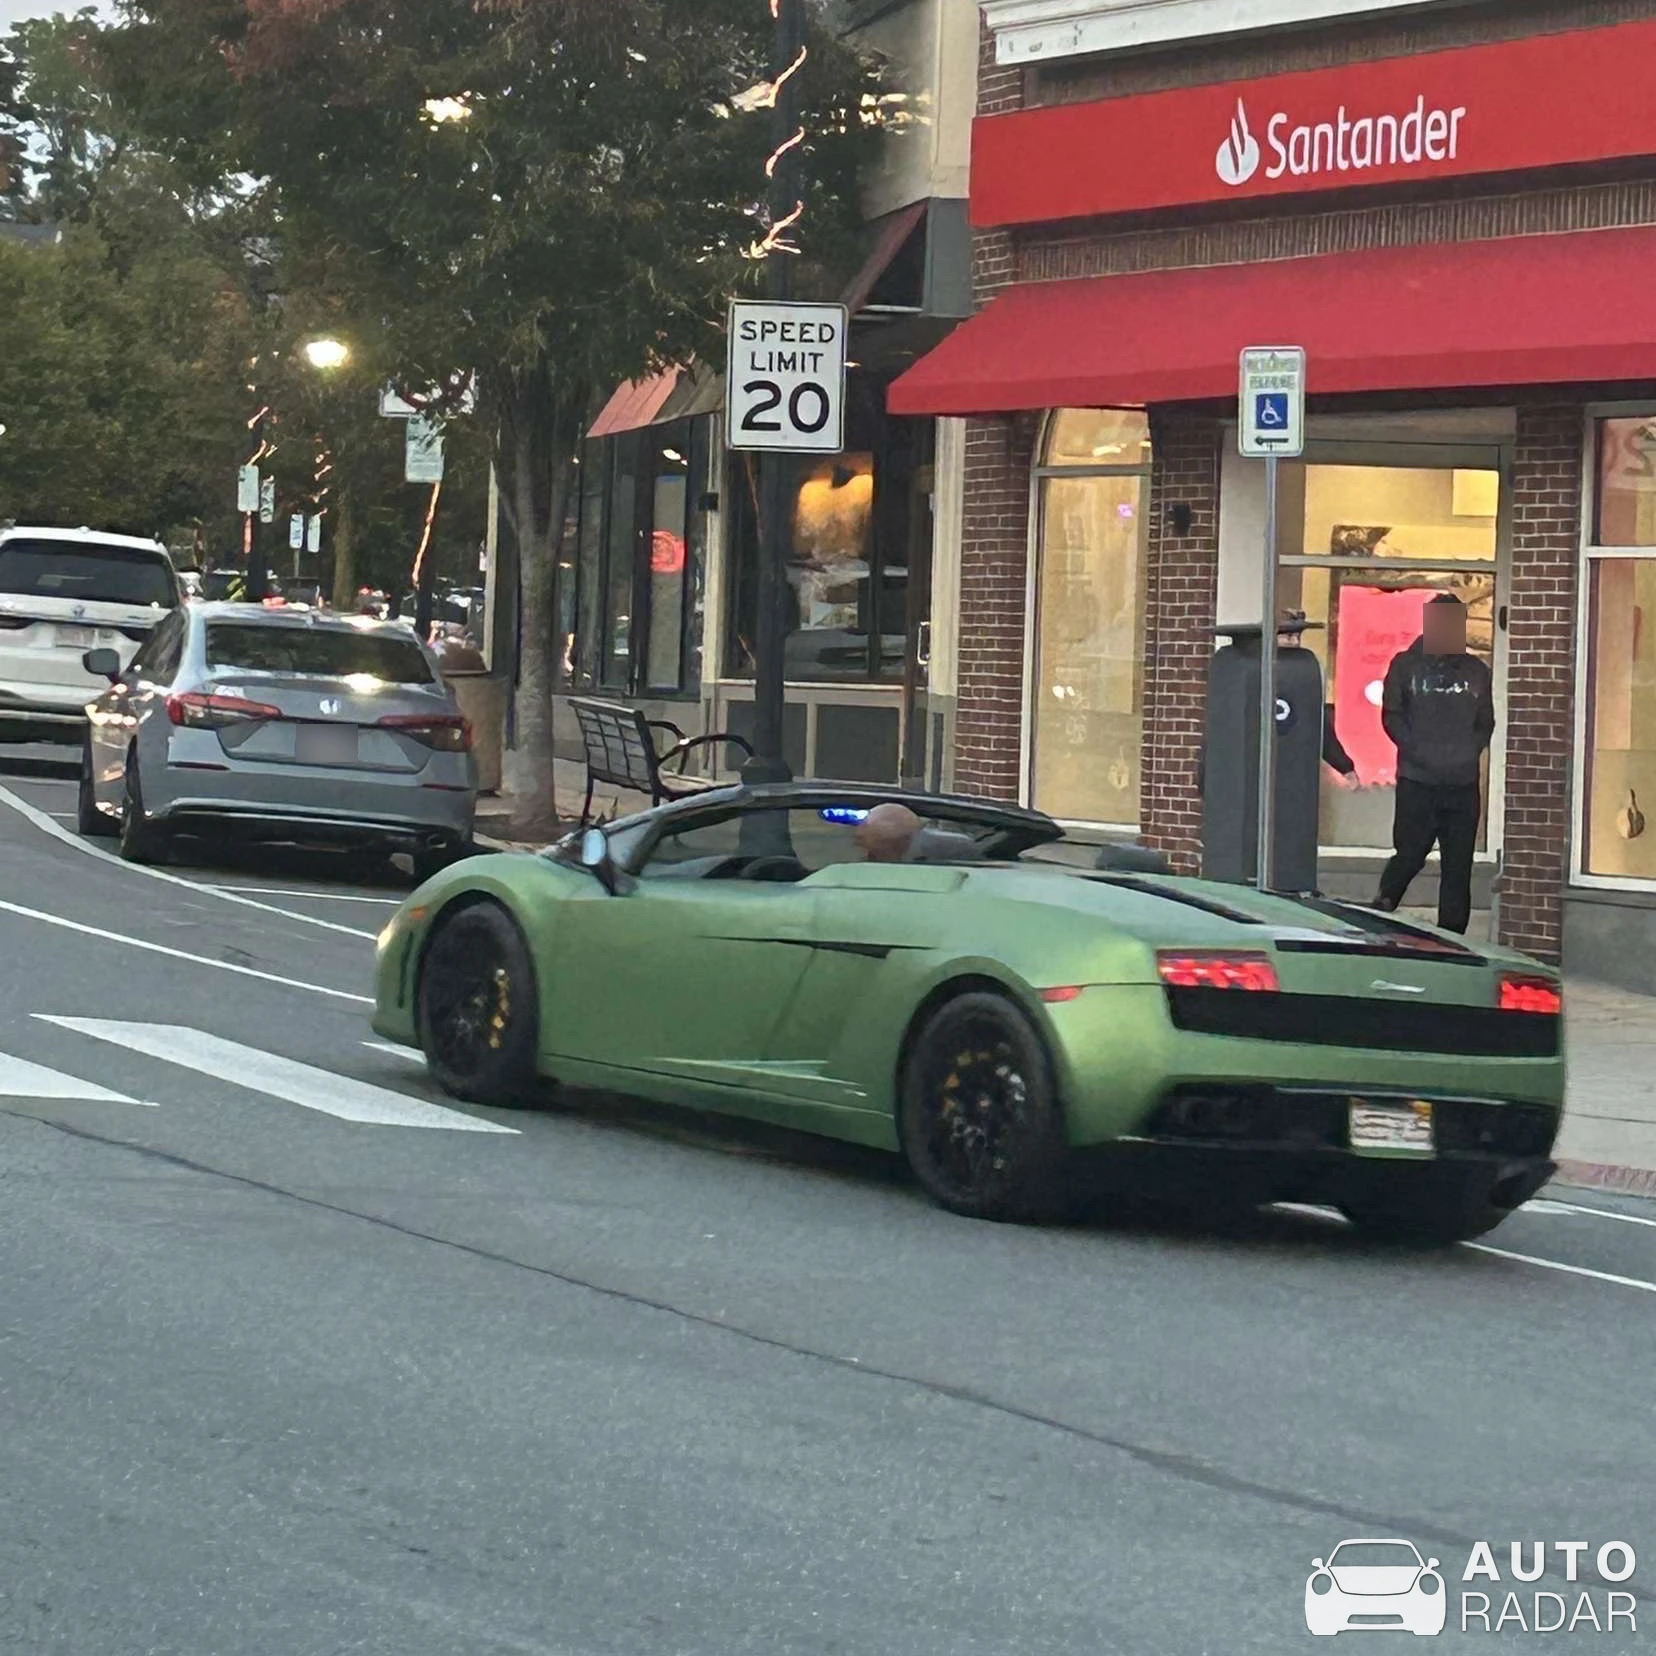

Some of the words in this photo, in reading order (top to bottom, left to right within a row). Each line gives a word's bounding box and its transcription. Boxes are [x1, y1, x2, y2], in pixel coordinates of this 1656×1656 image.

[1265, 94, 1466, 179] Santander
[740, 320, 835, 343] SPEED
[751, 351, 824, 373] LIMIT
[741, 380, 830, 434] 20
